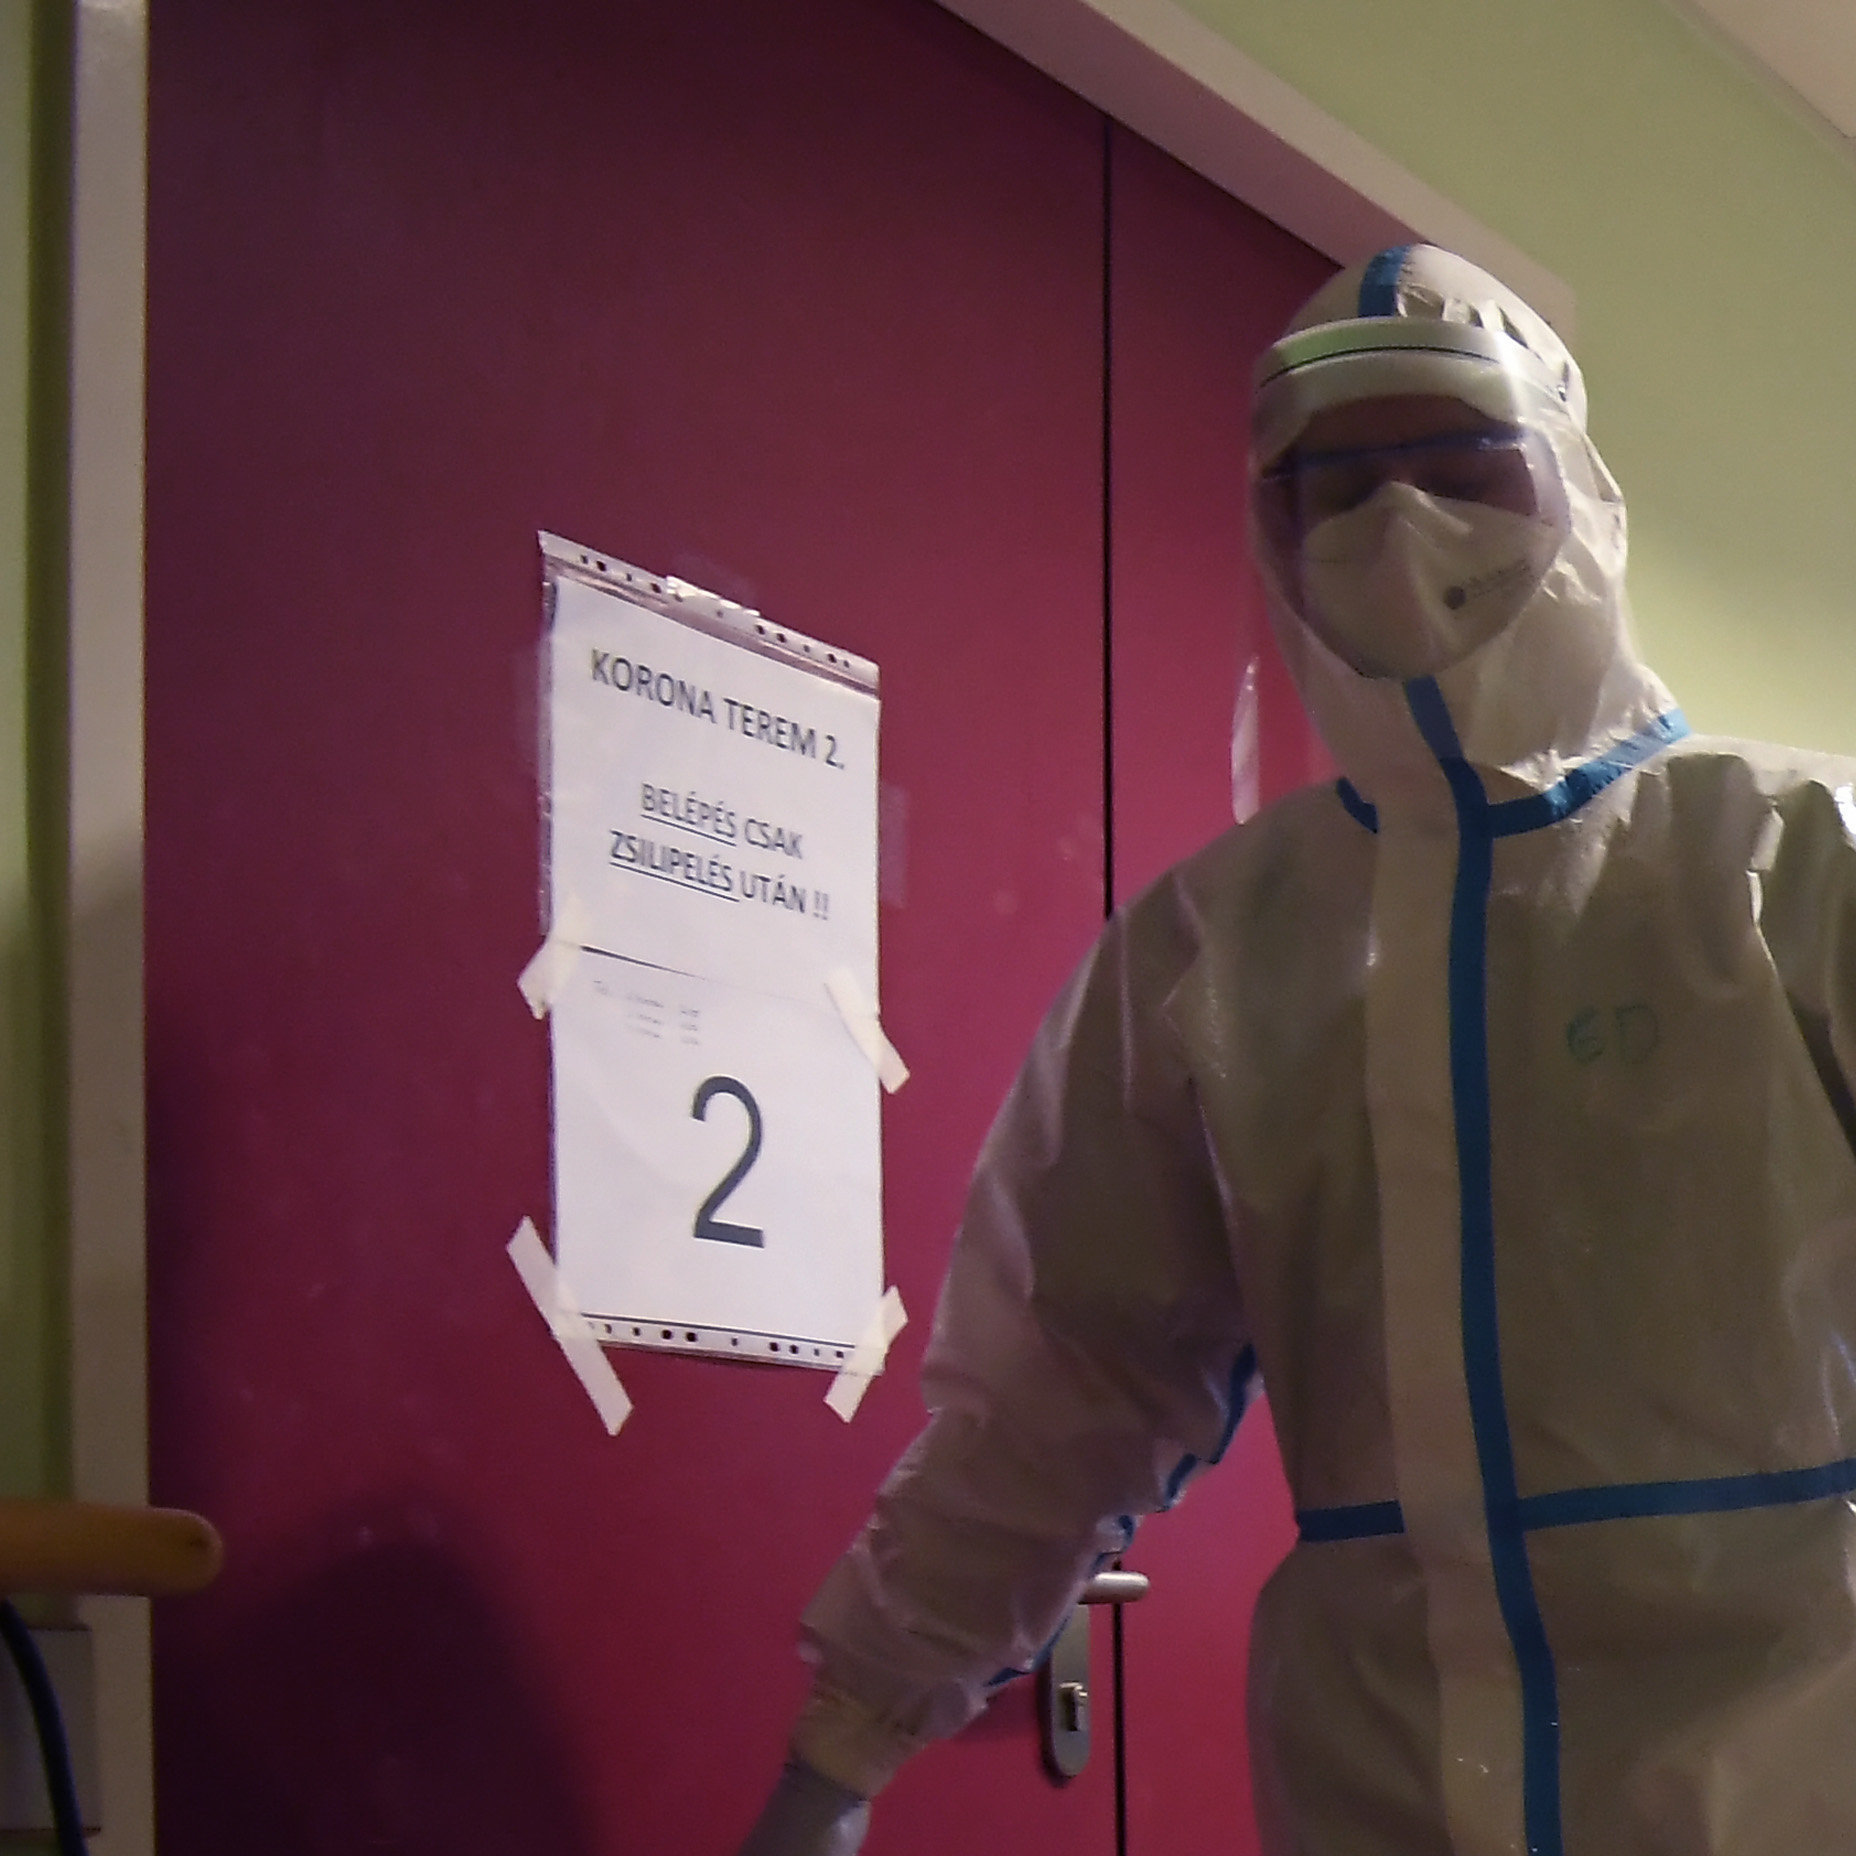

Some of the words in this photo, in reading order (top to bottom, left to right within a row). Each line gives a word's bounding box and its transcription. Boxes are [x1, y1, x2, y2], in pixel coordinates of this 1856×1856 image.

[591, 647, 717, 724] KORONA
[723, 697, 817, 759] TEREM
[825, 734, 845, 770] 2.
[609, 829, 733, 892] ZSILIPELÉS
[739, 870, 807, 914] UTÁN
[641, 782, 737, 839] BELÉPÉS
[744, 817, 804, 860] CSAK
[691, 1075, 765, 1249] 2
